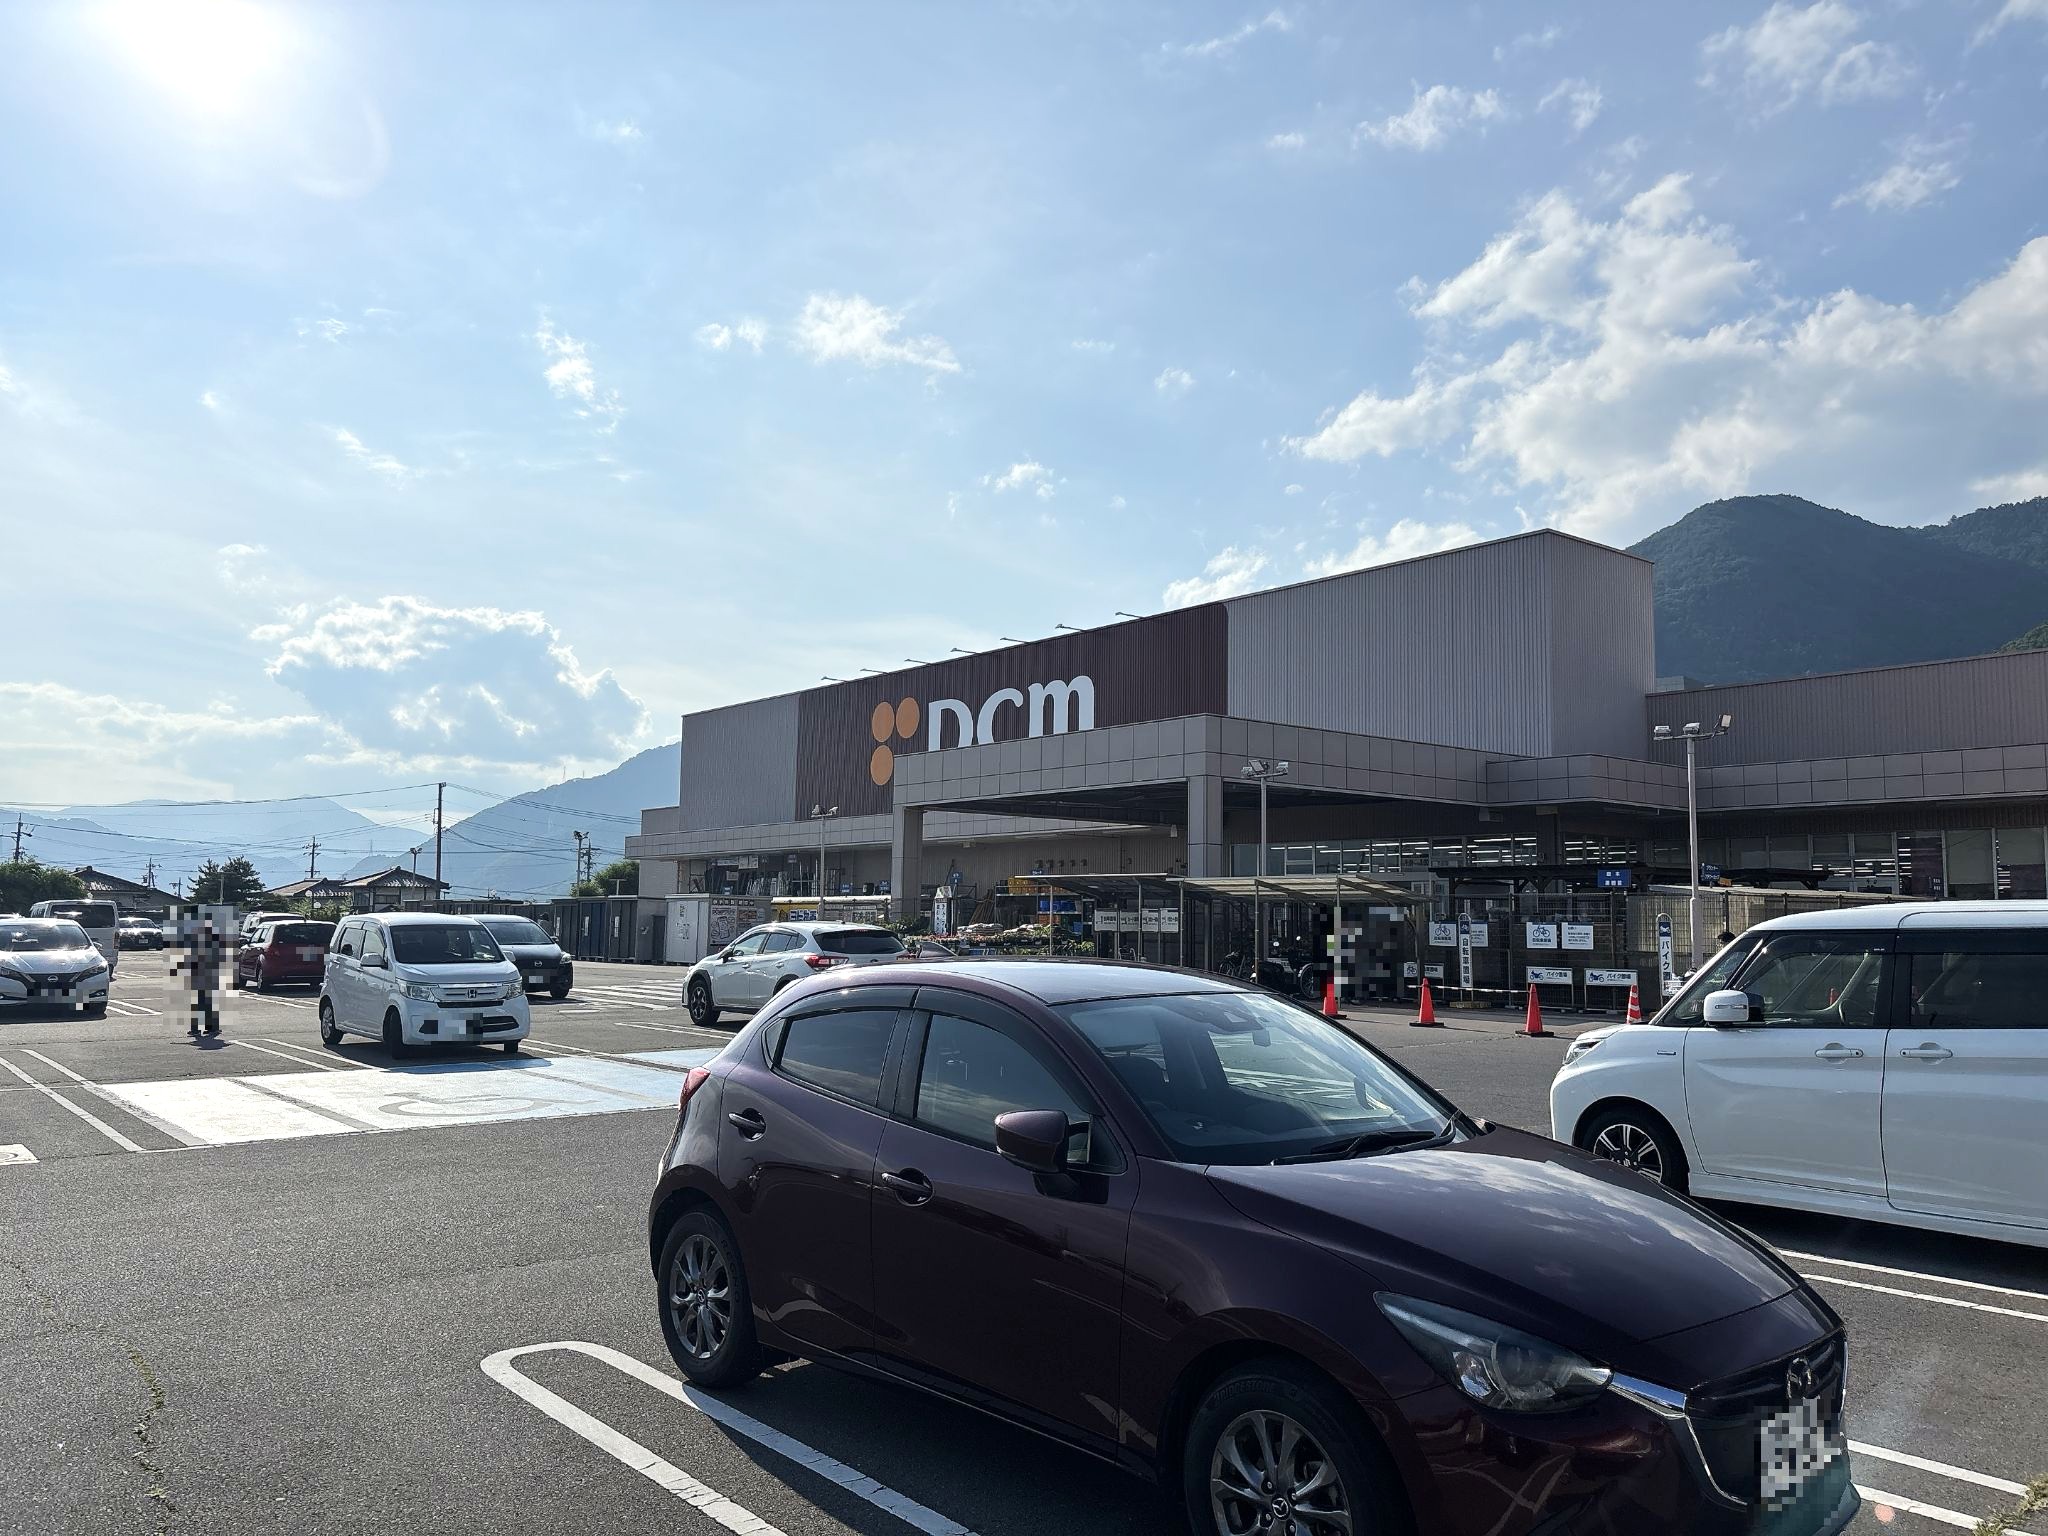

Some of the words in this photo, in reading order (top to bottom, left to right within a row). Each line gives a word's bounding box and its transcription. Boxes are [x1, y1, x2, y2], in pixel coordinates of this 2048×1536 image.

[1462, 937, 1470, 984] 自転車置場
[1661, 940, 1671, 990] バイク置
